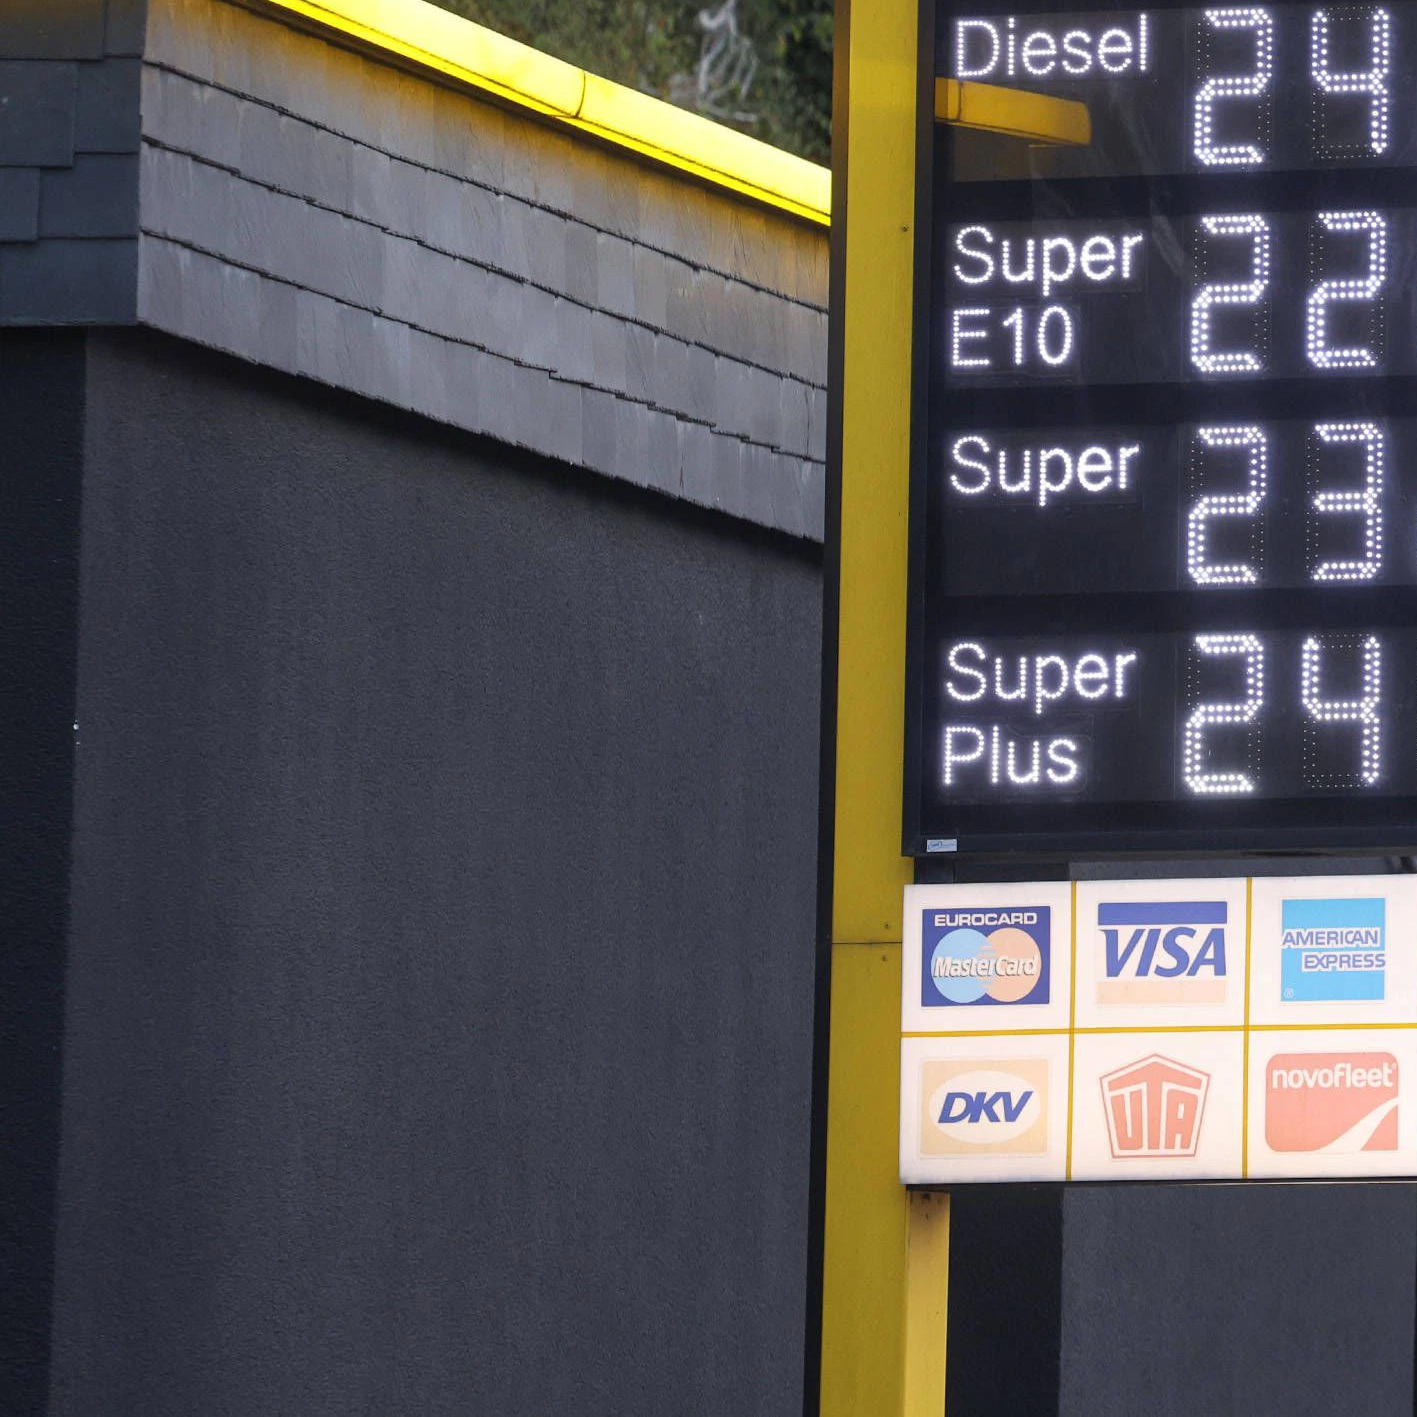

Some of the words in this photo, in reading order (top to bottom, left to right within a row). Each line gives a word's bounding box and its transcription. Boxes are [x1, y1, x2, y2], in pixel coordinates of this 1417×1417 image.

[954, 13, 1149, 78] Diesel
[953, 225, 1145, 297] Super
[951, 305, 1075, 368] E10
[950, 435, 1141, 507] Super
[945, 642, 1137, 714] Super
[942, 724, 1080, 785] Plus
[934, 912, 1038, 927] EUROCARD
[1282, 929, 1379, 946] AMERICAN
[932, 954, 1040, 978] MasterCard
[1098, 925, 1228, 979] VISA
[1303, 953, 1386, 970] EXPRESS
[1272, 1062, 1394, 1089] novofleet
[937, 1090, 1034, 1124] DKV
[1108, 1061, 1203, 1151] UTA
